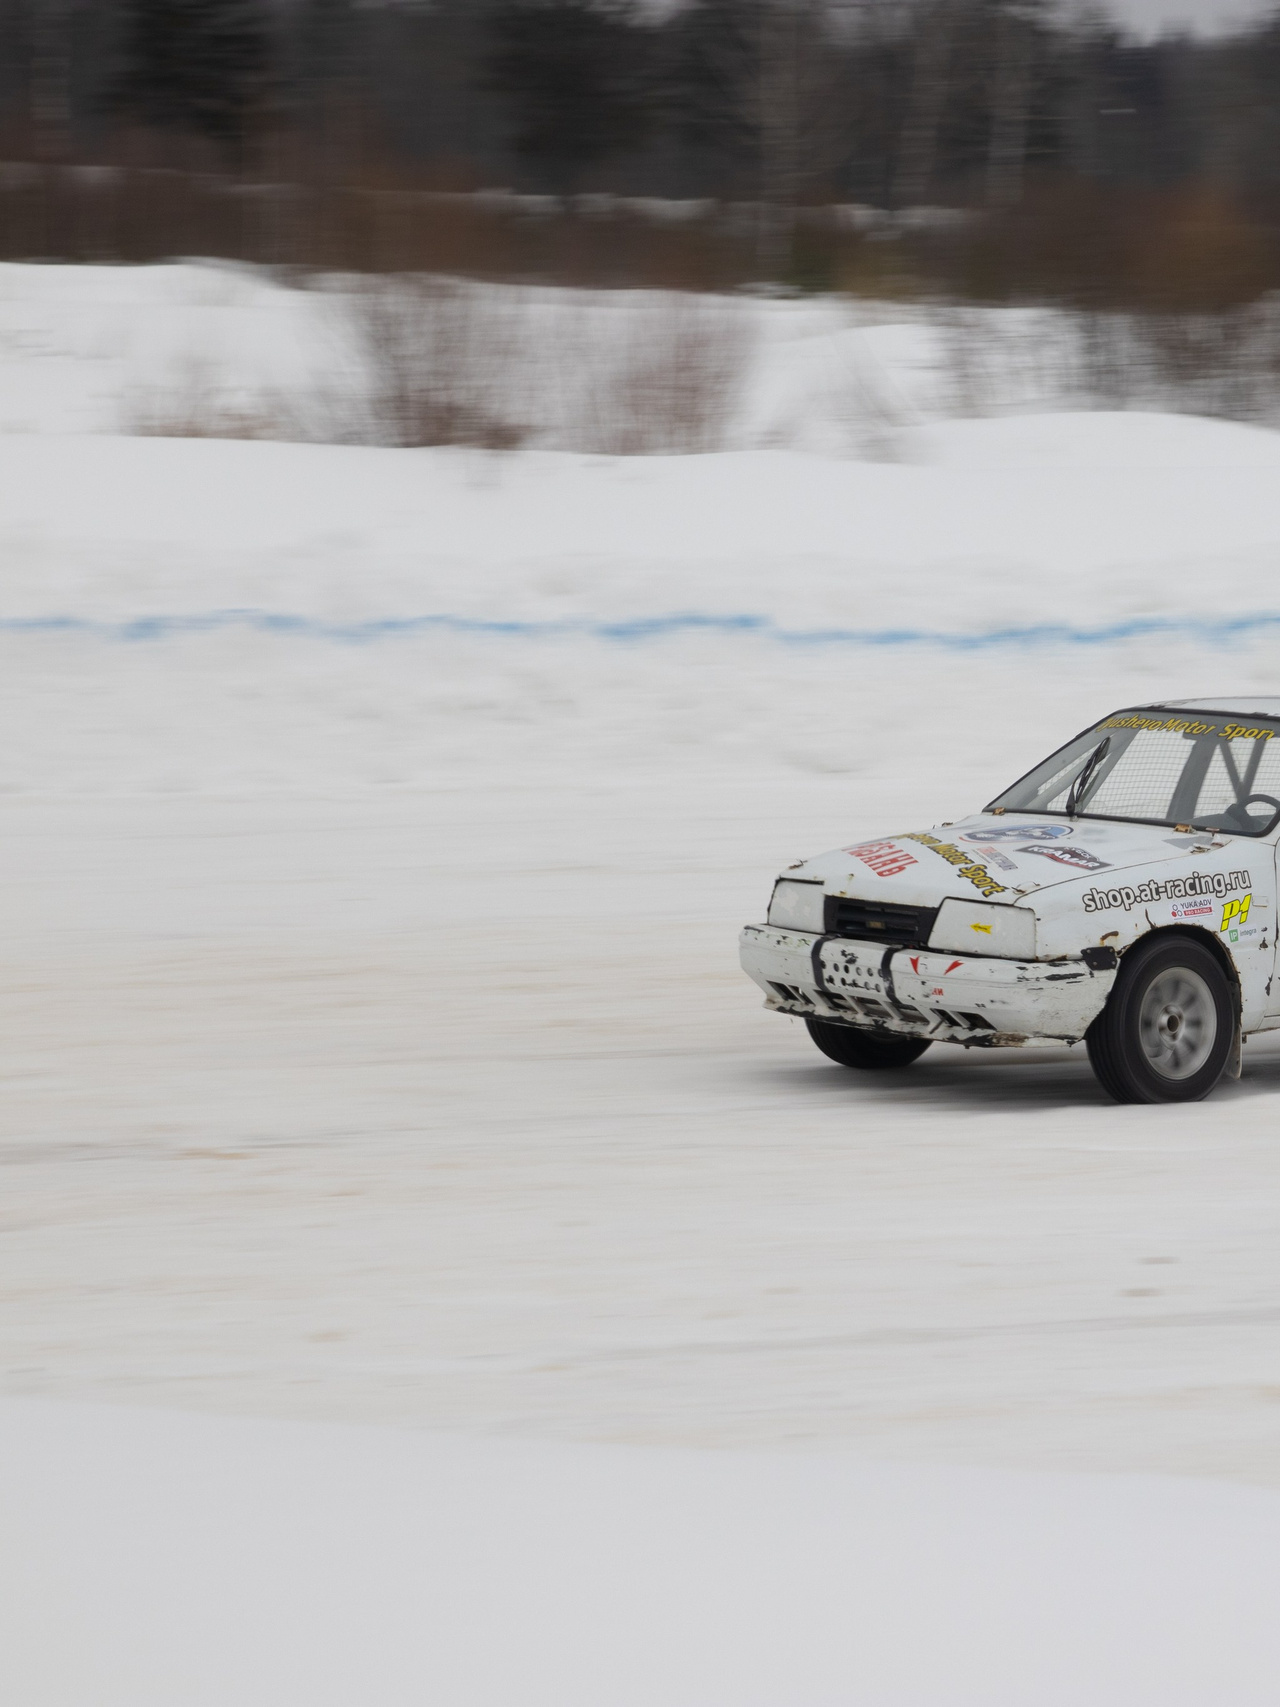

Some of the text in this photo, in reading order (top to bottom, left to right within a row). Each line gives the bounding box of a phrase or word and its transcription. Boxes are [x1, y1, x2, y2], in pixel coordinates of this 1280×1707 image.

[1028, 845, 1100, 868] KRAMAR
[956, 862, 1009, 898] Sport
[1082, 869, 1252, 912] shop.at-racing.ru
